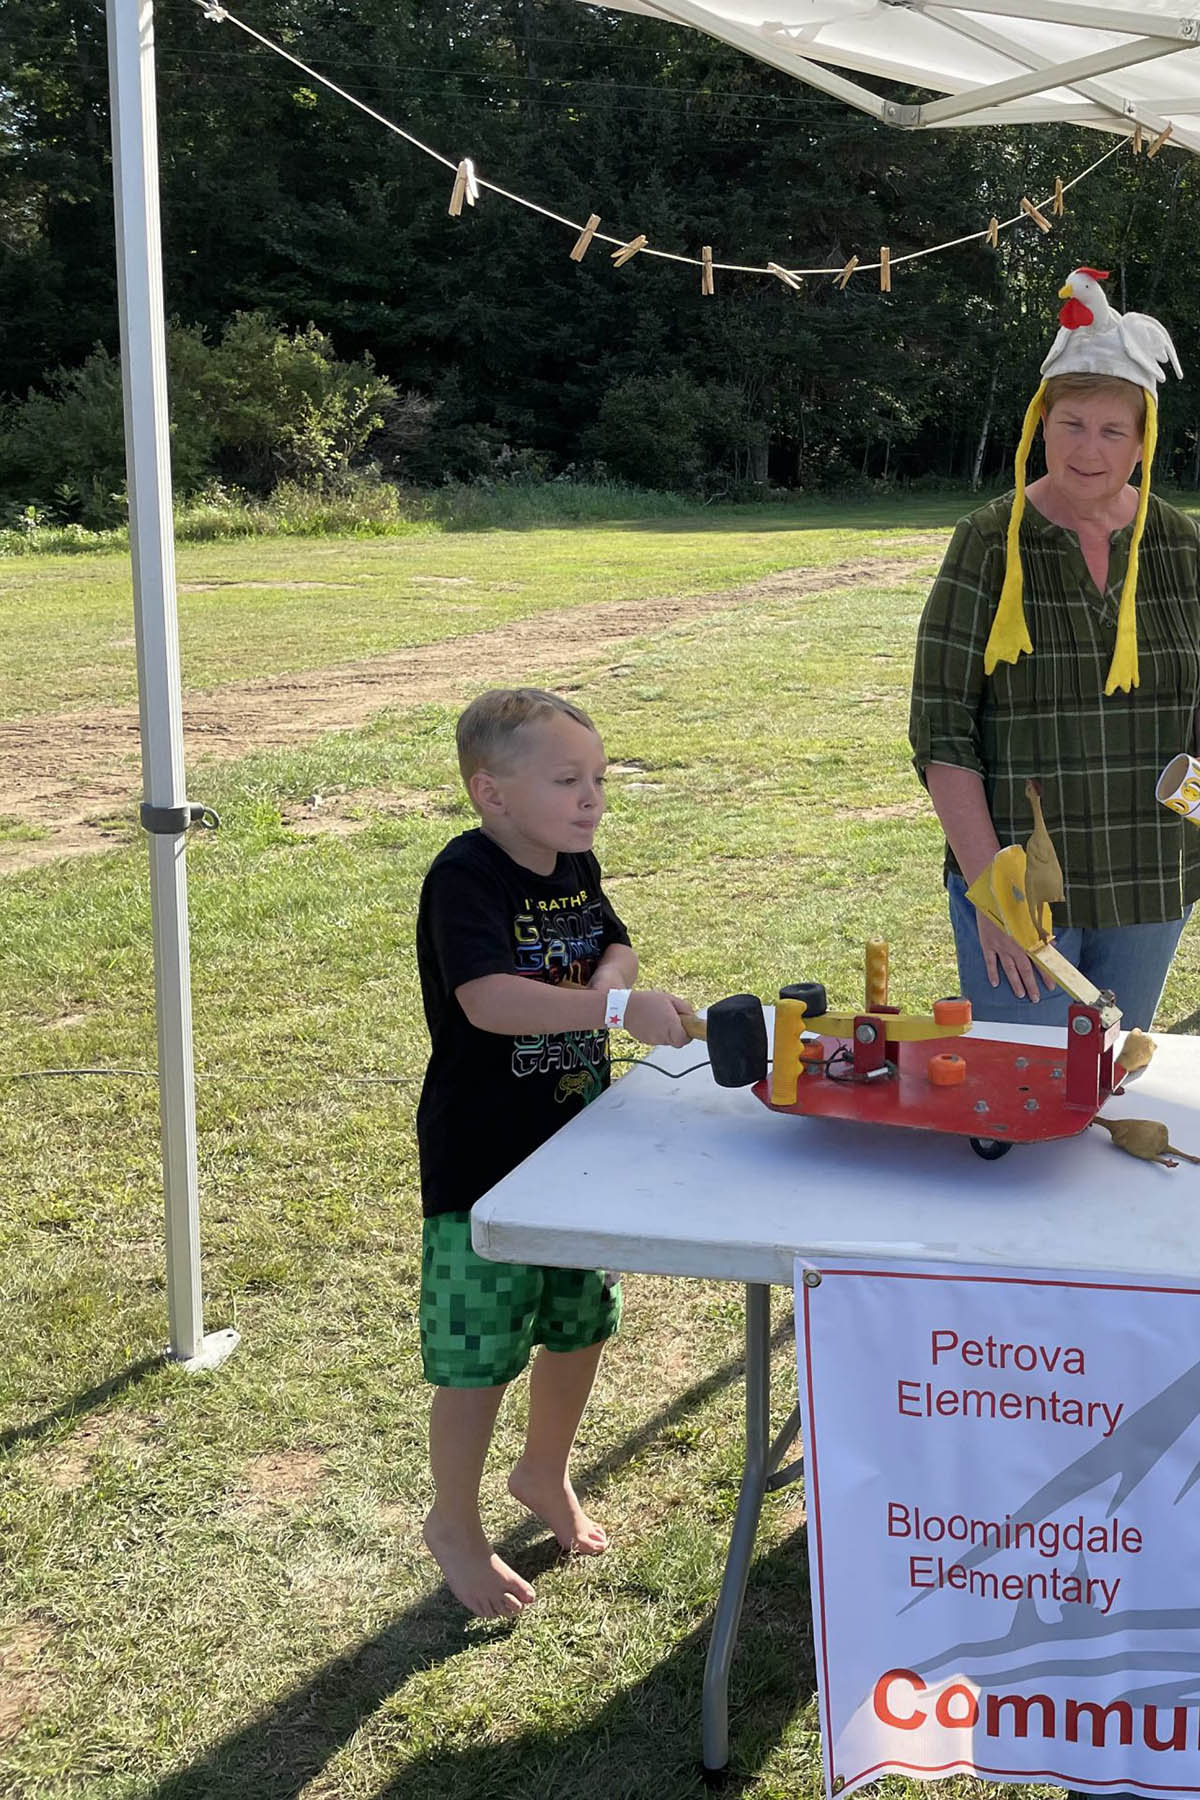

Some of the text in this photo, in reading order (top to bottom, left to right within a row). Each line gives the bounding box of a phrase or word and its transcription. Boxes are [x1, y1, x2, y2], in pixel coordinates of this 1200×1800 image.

[930, 1329, 1086, 1375] Petrova
[896, 1379, 1125, 1438] Elementary
[886, 1501, 1144, 1559] Bloomingdale
[908, 1555, 1122, 1615] Elementary
